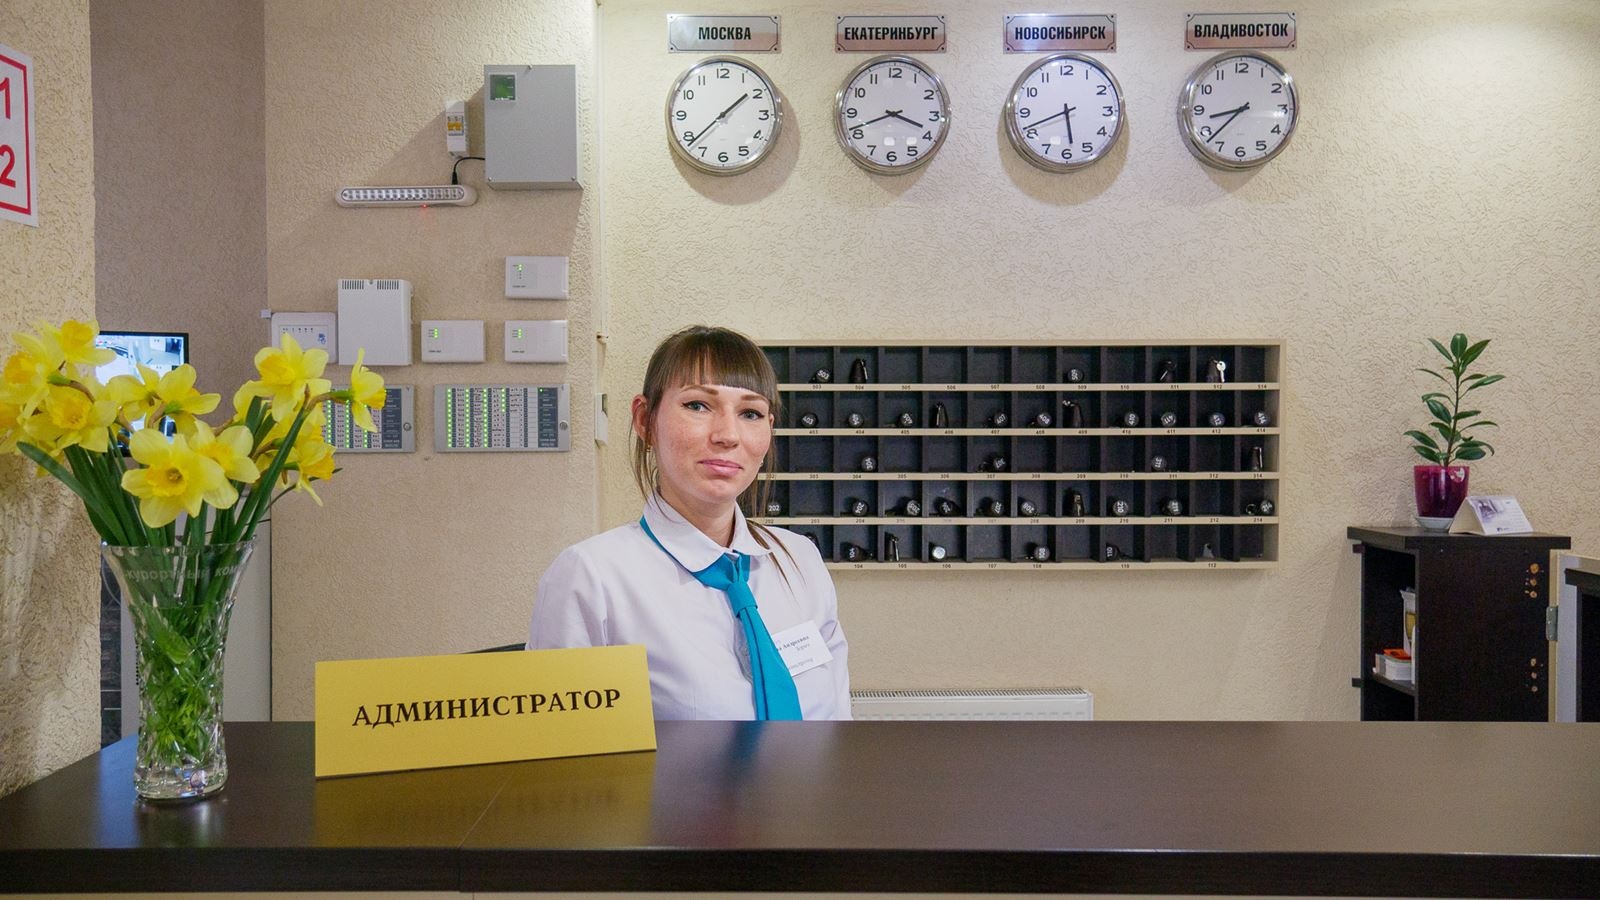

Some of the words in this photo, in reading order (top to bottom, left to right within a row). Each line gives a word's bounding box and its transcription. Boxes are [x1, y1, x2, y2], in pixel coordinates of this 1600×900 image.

[698, 26, 751, 40] МОСКВА
[844, 26, 938, 41] ЕКАТЕРИНБУРГ
[1015, 25, 1106, 41] НОВОСИБИРСК
[1194, 23, 1288, 38] ВЛАДИВОСТОК
[716, 68, 730, 79] 12
[888, 68, 902, 79] 12
[1060, 65, 1073, 76] 12
[1235, 63, 1249, 74] 12
[698, 74, 706, 85] 11
[870, 74, 878, 85] 11
[1041, 72, 1049, 83] 11
[1216, 69, 1224, 80] 11
[752, 88, 763, 99] 2
[854, 87, 866, 98] 10
[1027, 87, 1038, 98] 10
[1096, 85, 1107, 96] 2
[1201, 84, 1212, 95] 10
[1271, 83, 1282, 94] 2
[683, 89, 694, 100] 10
[923, 89, 934, 100] 2
[676, 110, 687, 121] 9
[758, 110, 769, 121] 3
[846, 108, 857, 119] 9
[1019, 107, 1030, 118] 9
[1103, 106, 1114, 117] 3
[1193, 105, 1204, 116] 9
[929, 111, 940, 122] 3
[853, 128, 864, 139] 8
[1026, 128, 1038, 139] 8
[1096, 125, 1107, 136] 4
[1270, 124, 1281, 135] 4
[922, 130, 933, 141] 4
[738, 145, 749, 156] 5
[866, 145, 876, 156] 7
[1041, 143, 1051, 154] 7
[1082, 142, 1093, 153] 5
[1215, 141, 1225, 152] 7
[1255, 140, 1266, 151] 5
[697, 146, 707, 157] 7
[718, 151, 728, 162] 6
[886, 151, 897, 162] 6
[907, 146, 918, 157] 5
[1061, 149, 1072, 160] 6
[1235, 146, 1245, 157] 6
[352, 689, 621, 729] АДМИНИСТРАТОР
